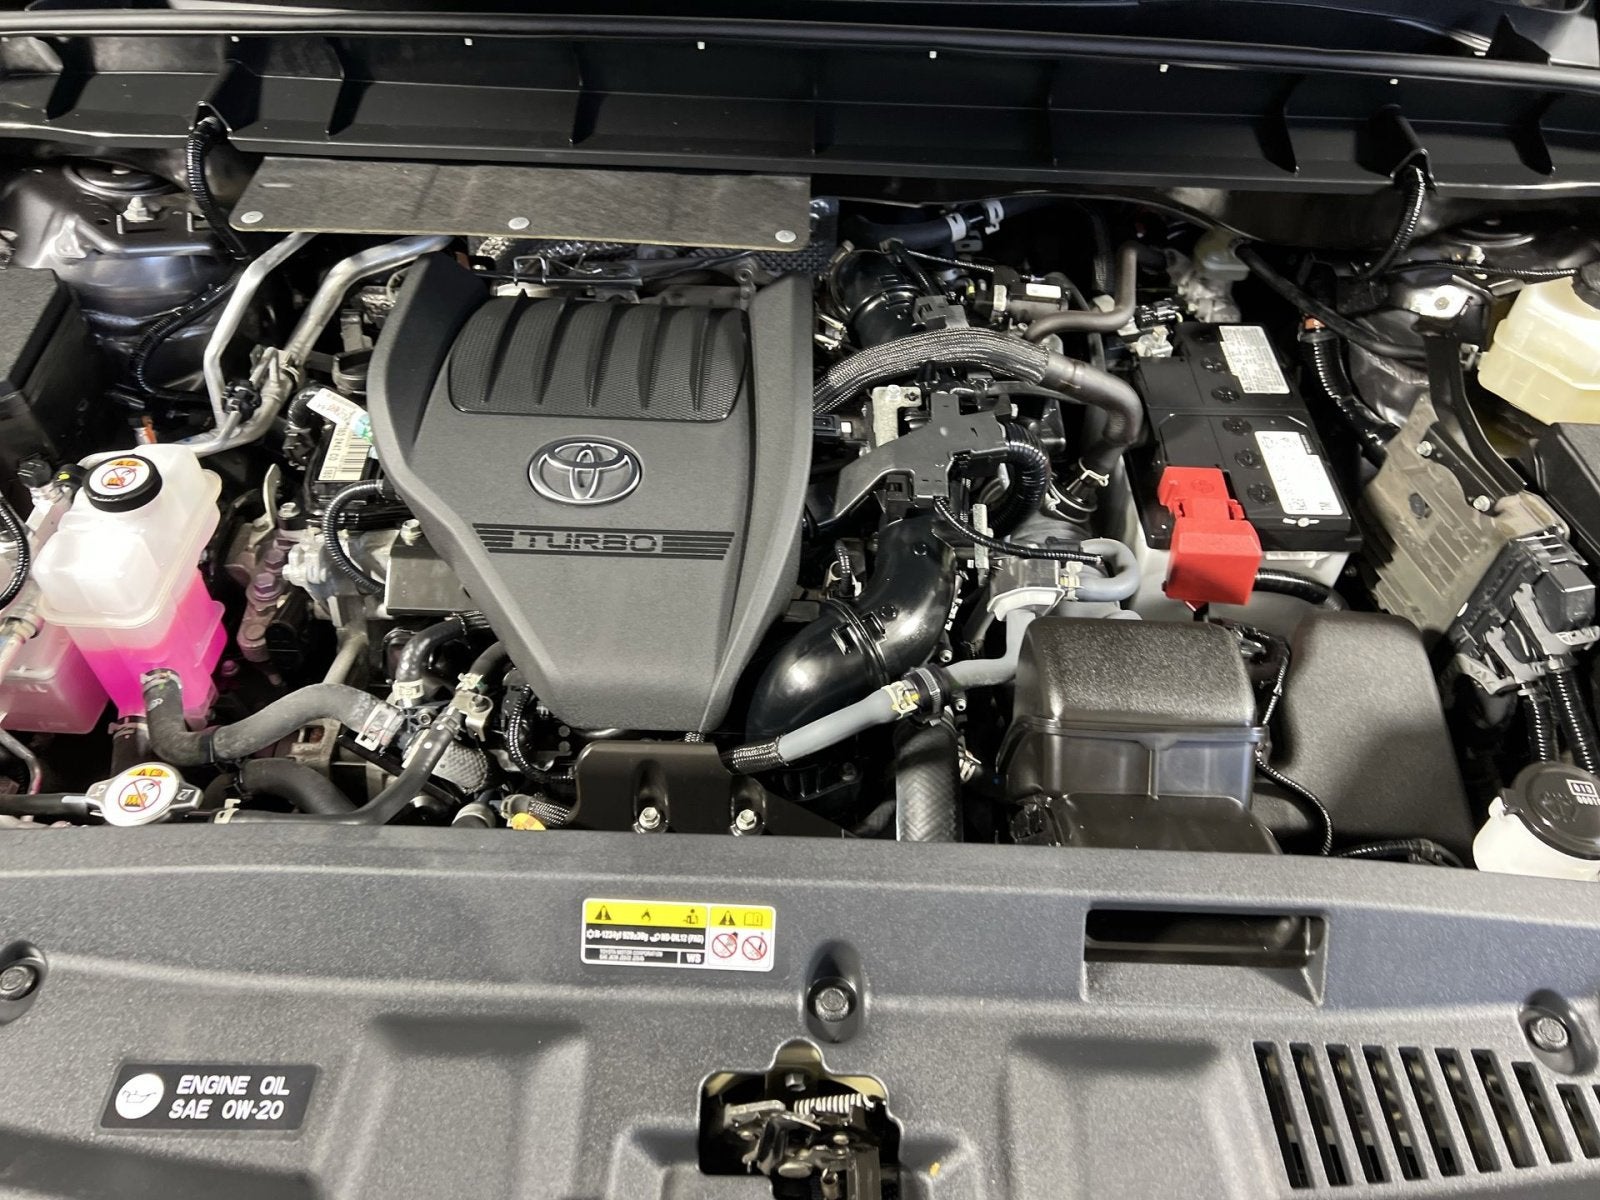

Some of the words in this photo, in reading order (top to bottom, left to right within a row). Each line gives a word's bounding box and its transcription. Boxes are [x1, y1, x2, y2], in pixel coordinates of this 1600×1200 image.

[518, 531, 657, 552] TURBO
[686, 953, 701, 963] WS
[175, 1074, 250, 1095] ENGINE
[259, 1076, 290, 1096] OIL
[168, 1098, 213, 1119] SAE
[221, 1100, 284, 1120] 0W-20
